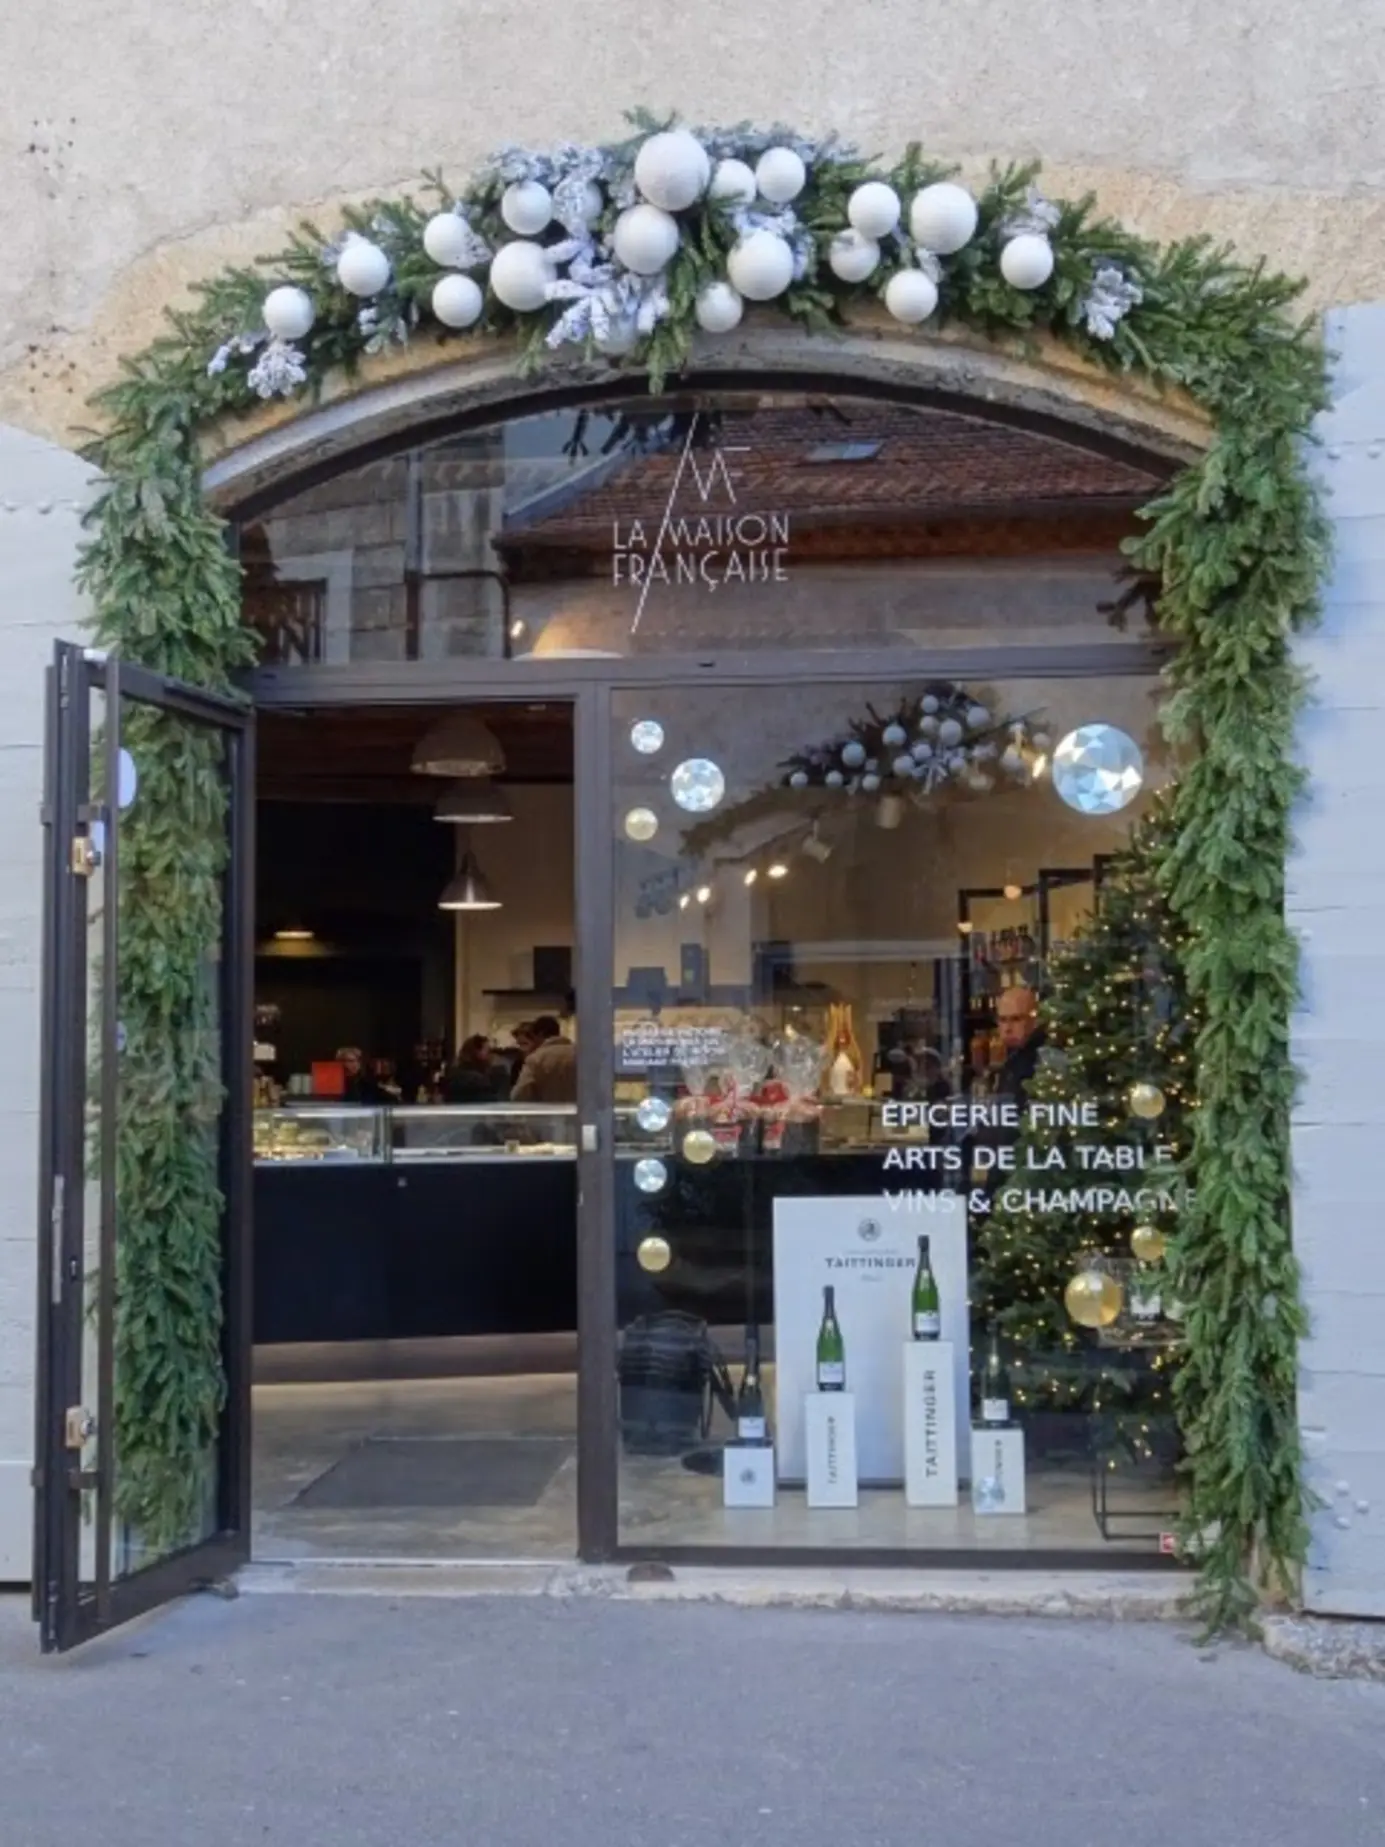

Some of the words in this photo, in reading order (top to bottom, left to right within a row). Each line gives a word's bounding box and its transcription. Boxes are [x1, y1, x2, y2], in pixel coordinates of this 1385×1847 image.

[613, 520, 647, 550] LA
[657, 514, 789, 547] MAISON
[613, 548, 789, 593] FRANÇAISE
[1030, 1103, 1100, 1128] FINE
[882, 1145, 962, 1170] ARTS
[973, 1146, 1016, 1170] DE
[1027, 1146, 1065, 1170] LA
[882, 1188, 956, 1213] VINS
[968, 1188, 991, 1213] &
[824, 1257, 916, 1269] TAITTINGER
[923, 1369, 937, 1479] TAITTINGER
